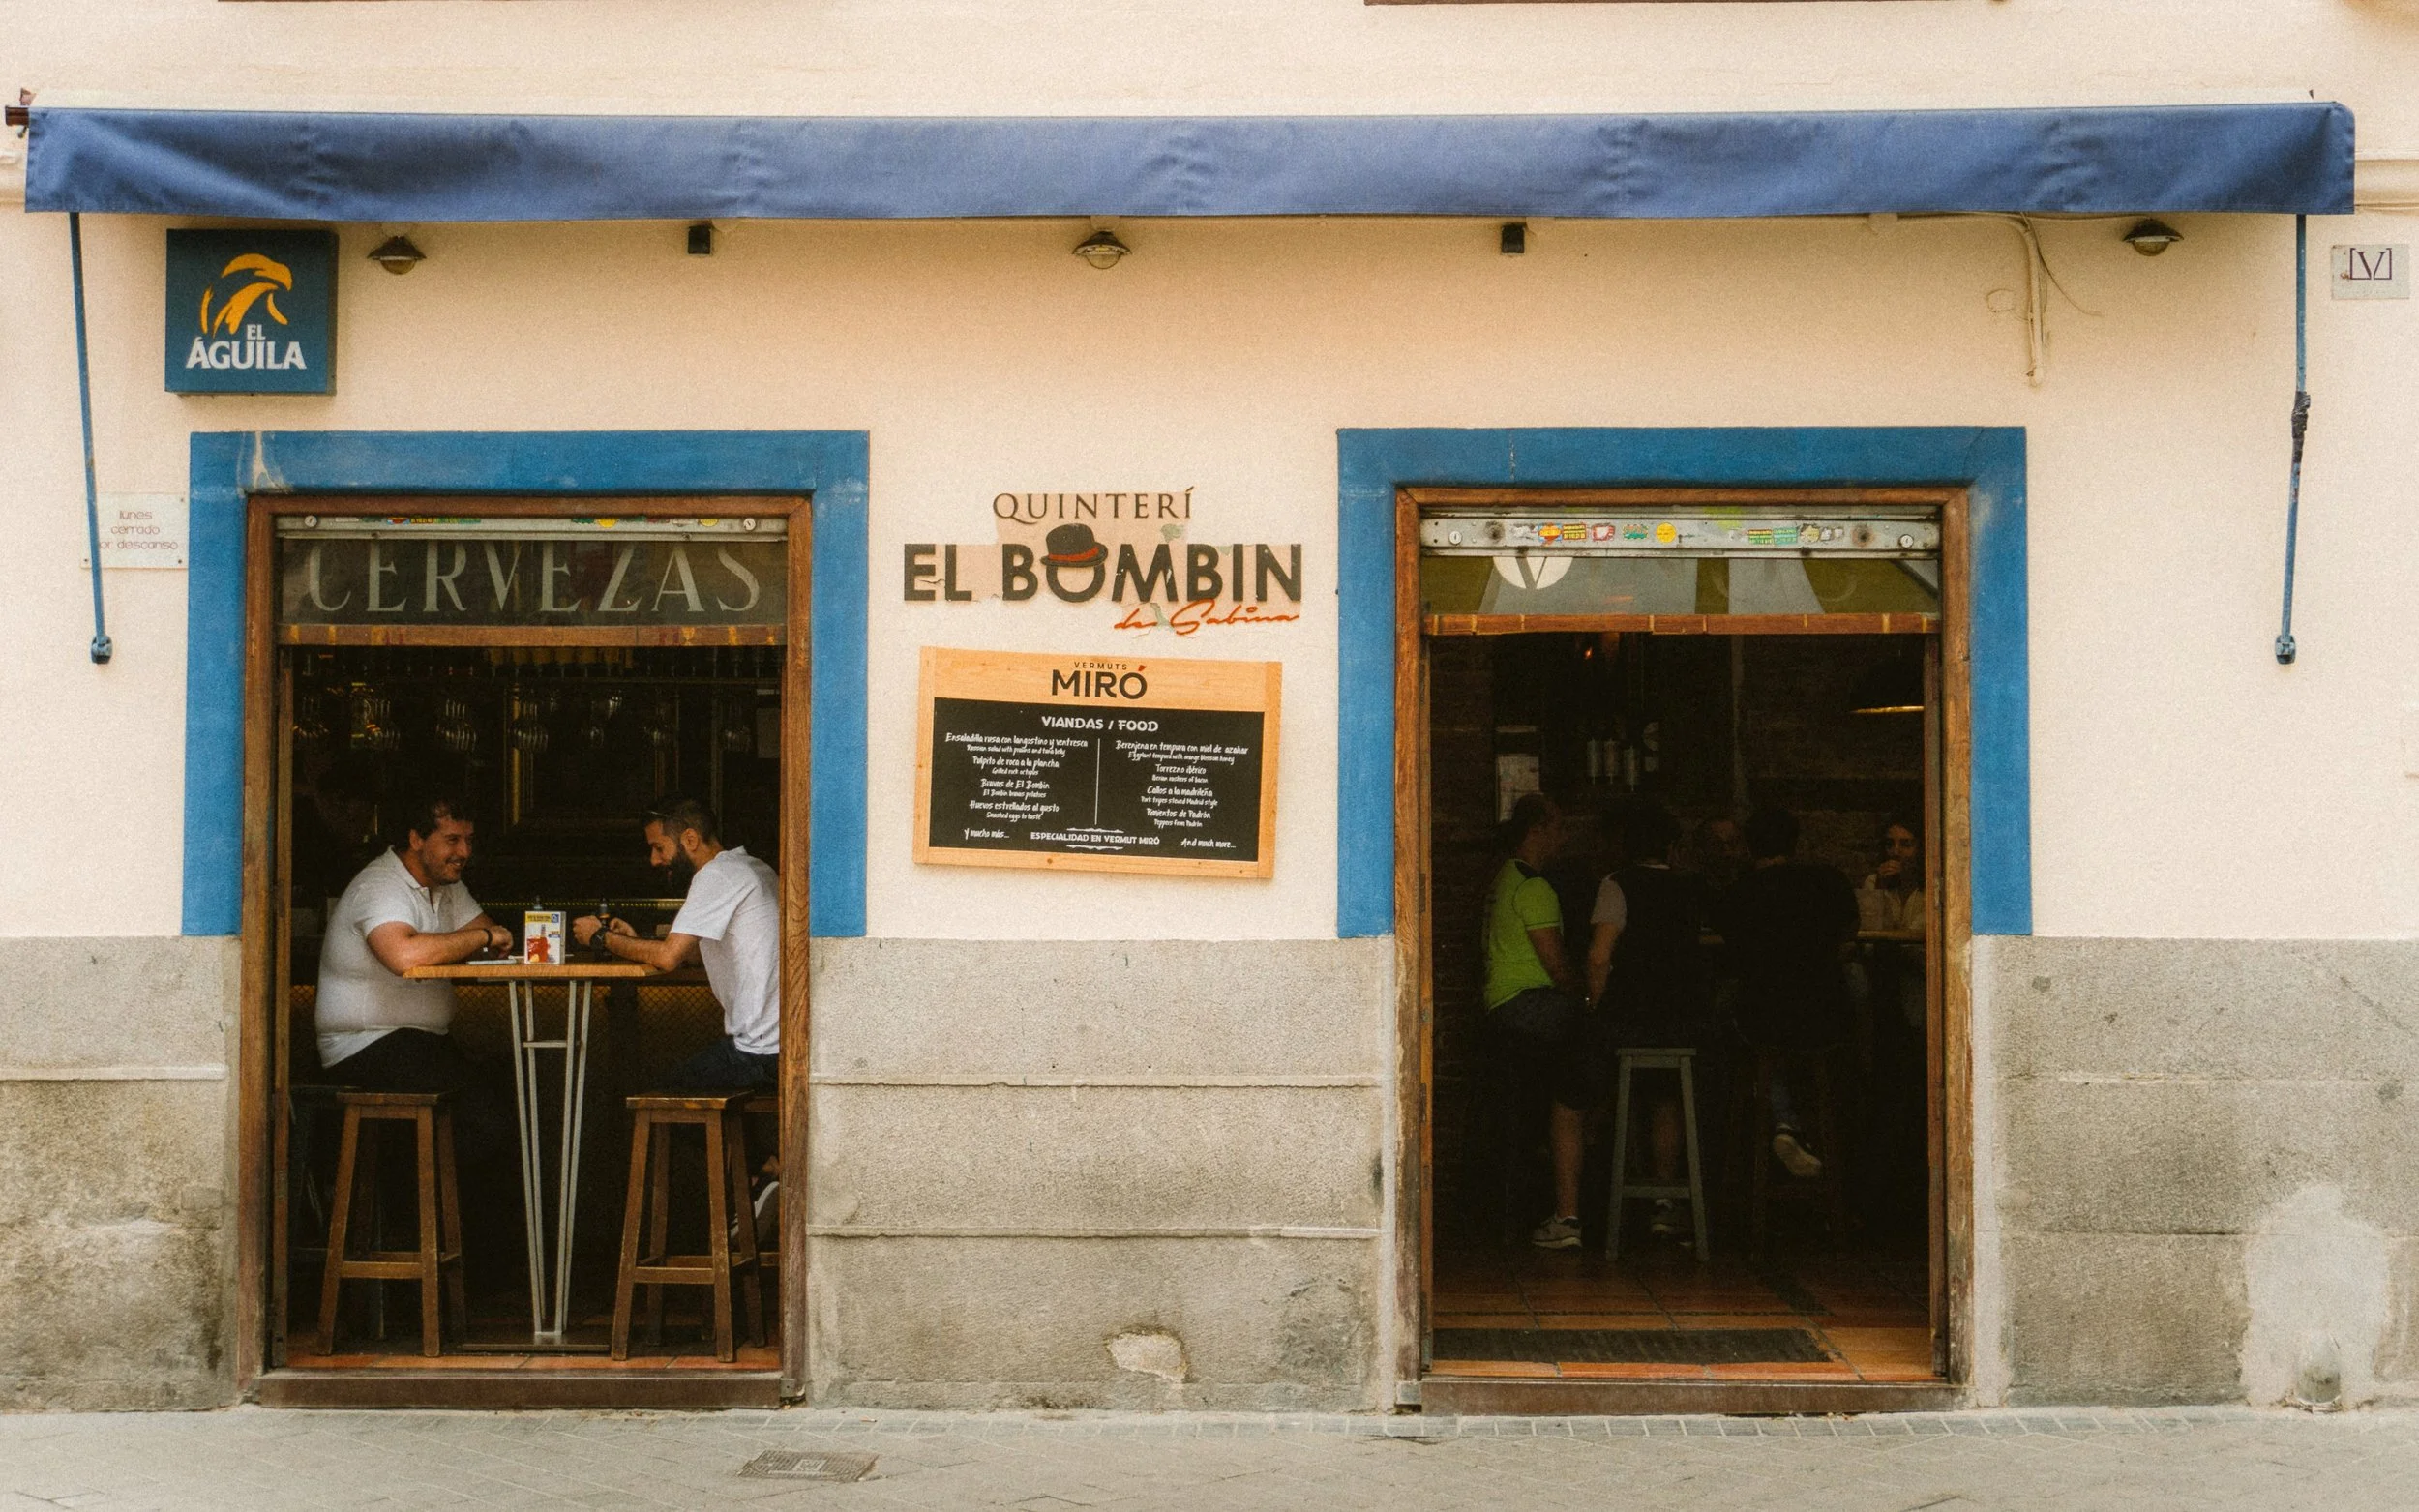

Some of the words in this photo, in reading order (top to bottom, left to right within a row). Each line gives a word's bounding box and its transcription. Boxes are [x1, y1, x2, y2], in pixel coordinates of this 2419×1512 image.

[247, 324, 266, 341] EL
[185, 336, 307, 370] ÁGUILA
[992, 487, 1195, 526] QUINTERÍ
[119, 510, 153, 519] lunes
[110, 525, 161, 535] cerrado
[117, 541, 178, 549] descanso
[307, 542, 762, 612] CERVEZAS
[903, 543, 972, 602] EL
[1001, 543, 1302, 603] BOMBIN
[1114, 608, 1157, 629] de
[1170, 598, 1299, 636] Sabina
[1074, 662, 1127, 670] VERMUTS
[1051, 665, 1148, 699] MIRÓ
[1041, 716, 1103, 729] VIANDAS
[1108, 720, 1114, 730] /
[1118, 720, 1159, 732] FOOD
[945, 732, 983, 742] Ensaladilla
[1013, 735, 1048, 748] langostino
[1049, 739, 1055, 750] y
[1056, 737, 1088, 747] ventresca
[1116, 740, 1149, 753] Berenjena
[1159, 742, 1186, 755] tempura
[1200, 744, 1212, 753] miel
[1212, 744, 1223, 753] de
[1224, 745, 1249, 754] azahar
[996, 756, 1005, 765] de
[1026, 757, 1032, 766] la
[1032, 758, 1060, 770] plancha
[1155, 764, 1185, 773] Torrezno
[1185, 765, 1207, 774] ibérico
[980, 778, 1004, 788] Bravas
[1005, 779, 1014, 787] de
[1015, 780, 1025, 788] El
[1147, 786, 1167, 794] Callos
[1174, 786, 1180, 795] la
[1181, 787, 1213, 797] madrileña
[970, 800, 994, 809] Huevos
[994, 801, 1031, 812] estrellados
[1031, 803, 1039, 812] al
[1039, 804, 1060, 816] gusto
[1147, 808, 1178, 817] Pimientos
[1178, 809, 1187, 817] de
[1187, 810, 1211, 819] Padrón
[1030, 831, 1090, 842] ESPECIALIDAD
[1090, 834, 1102, 843] EN
[1104, 835, 1138, 844] VERMUT
[1139, 835, 1161, 845] MIRÓ
[1181, 838, 1197, 847] And
